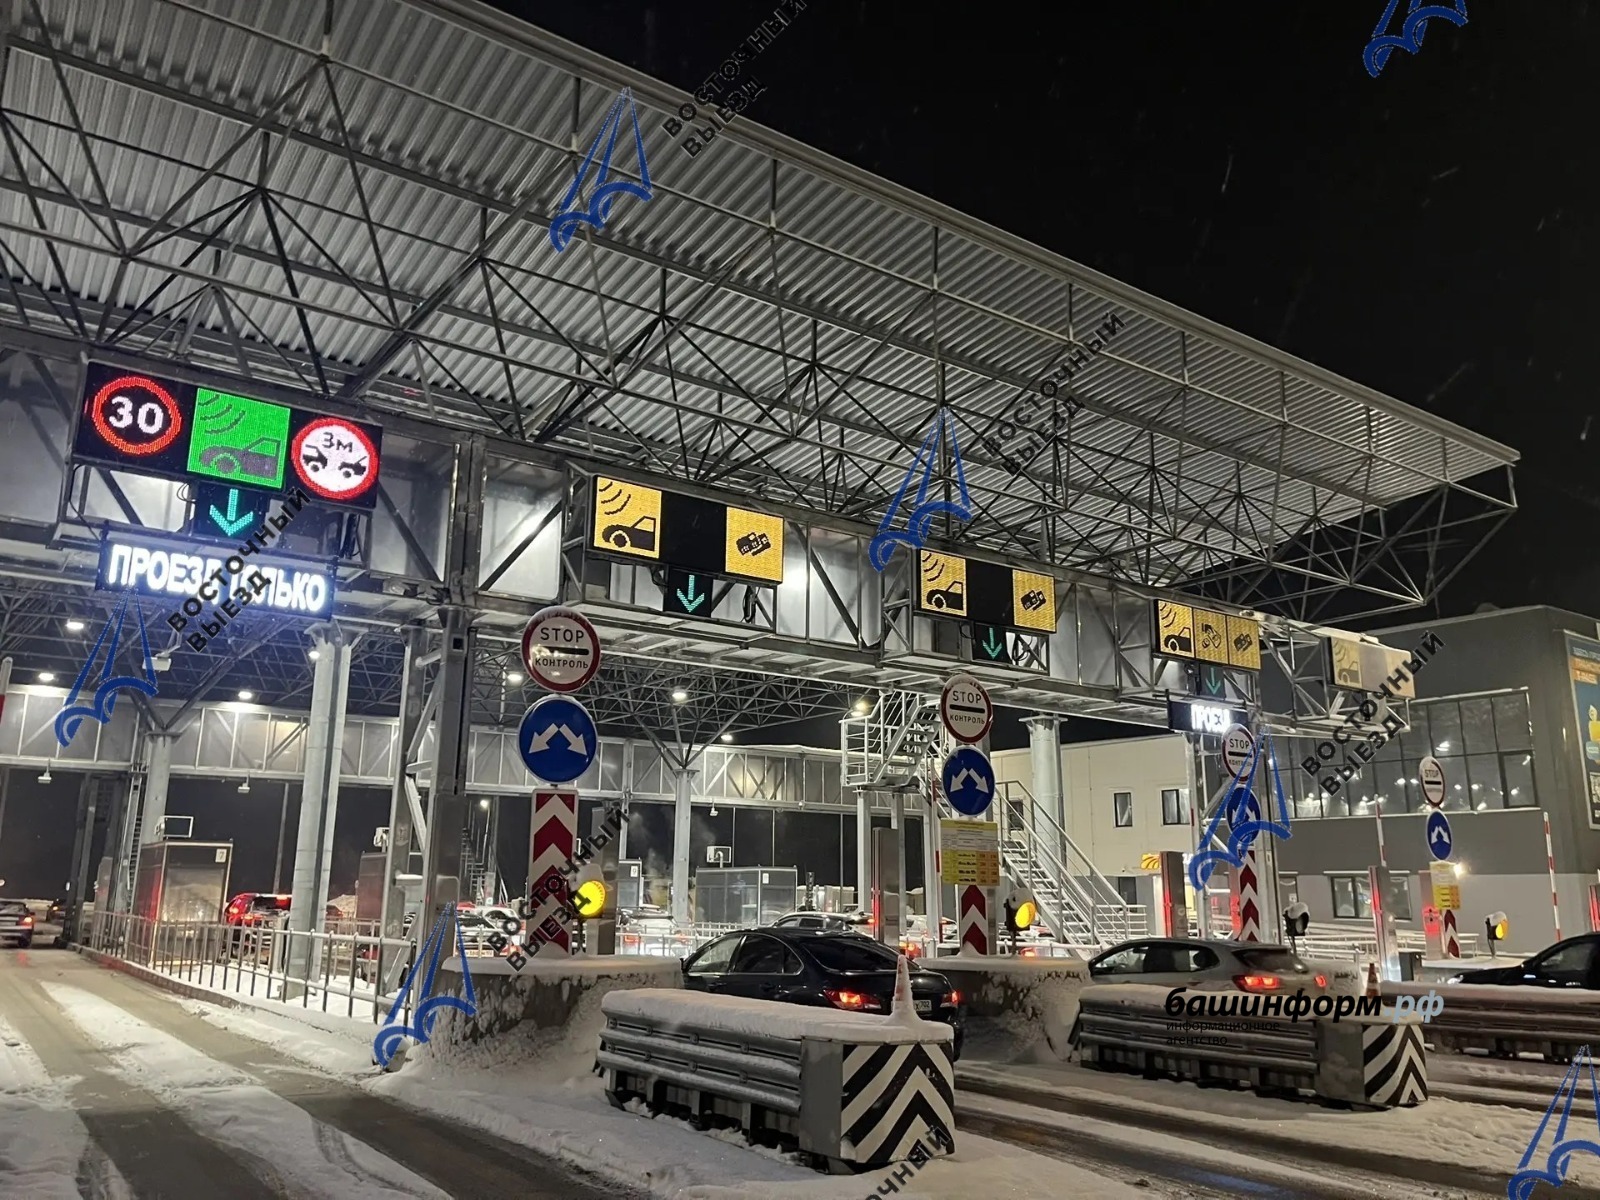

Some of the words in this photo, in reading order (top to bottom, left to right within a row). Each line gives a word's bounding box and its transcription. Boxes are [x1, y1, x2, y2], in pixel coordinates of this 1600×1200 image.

[109, 396, 164, 434] 30
[540, 627, 585, 643] STOP
[535, 658, 589, 669] КОНТРОЛЬ
[952, 690, 982, 704] STOP
[949, 714, 985, 725] КОНТРОЛЬ
[1229, 738, 1250, 749] STOP
